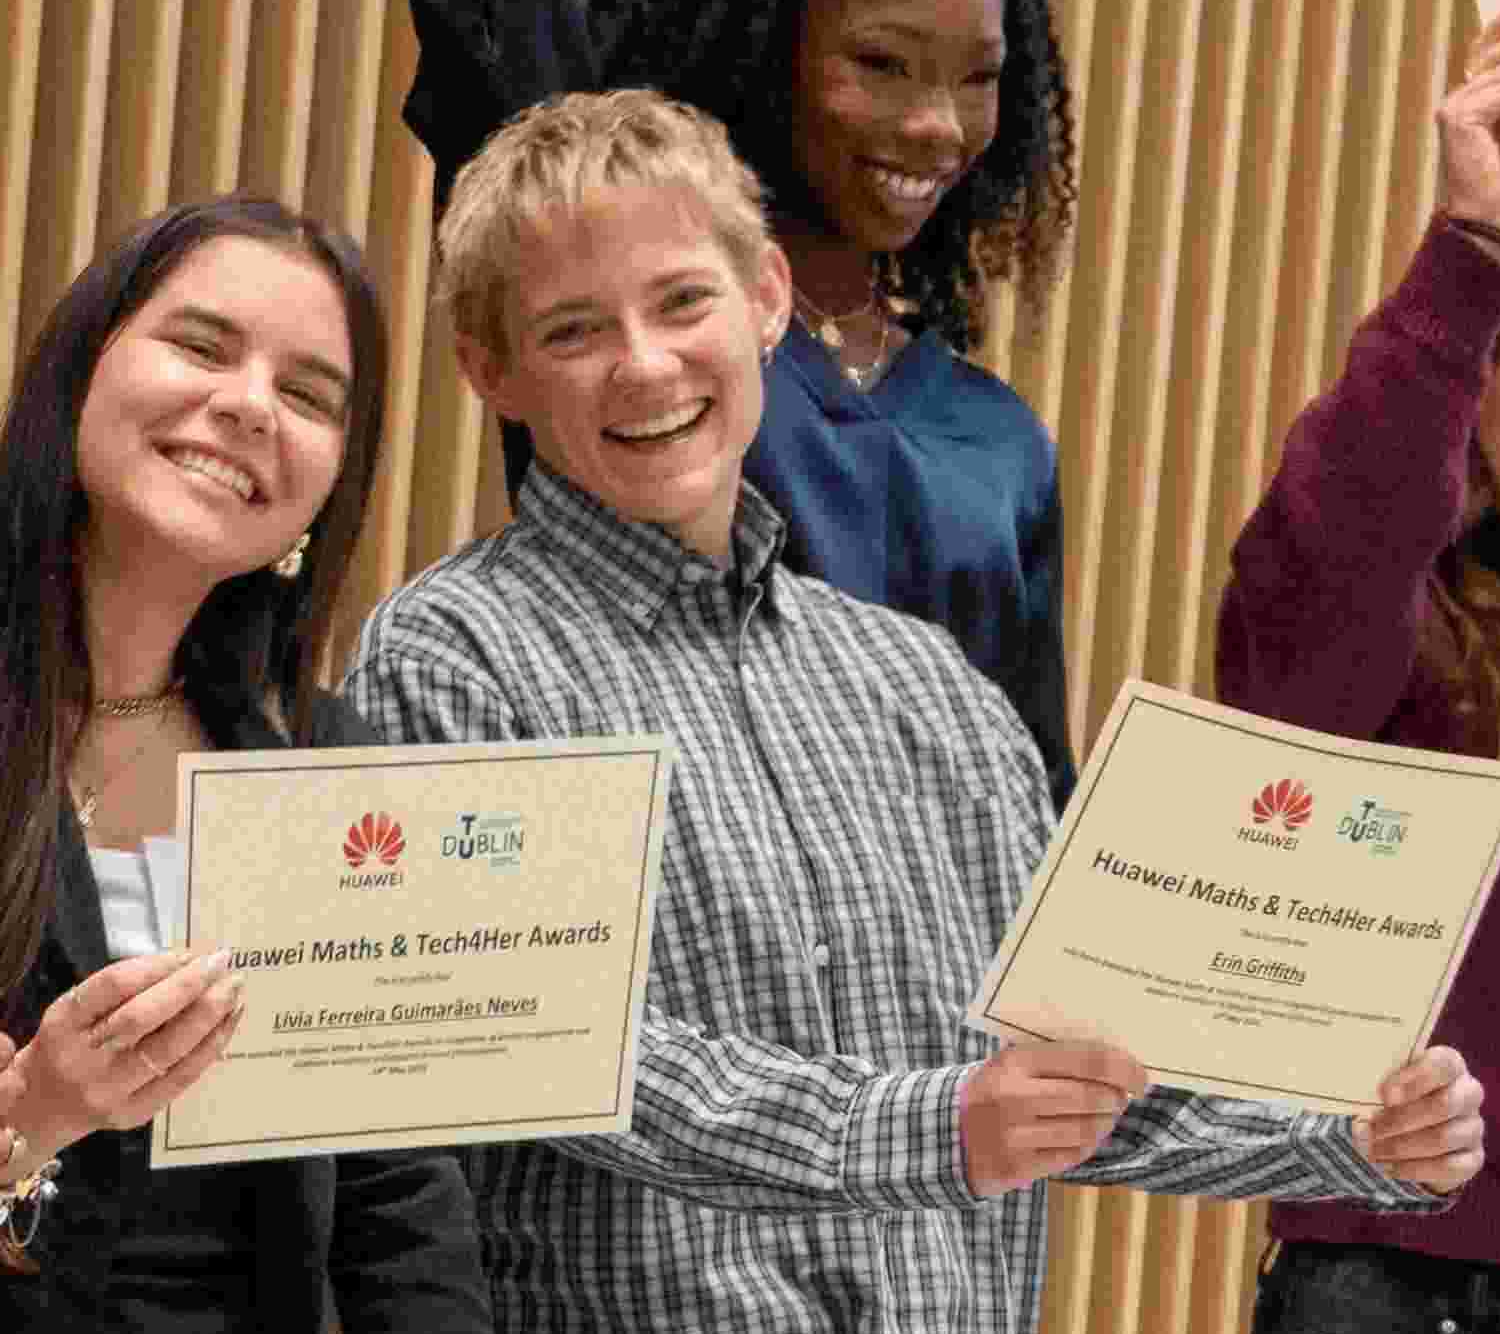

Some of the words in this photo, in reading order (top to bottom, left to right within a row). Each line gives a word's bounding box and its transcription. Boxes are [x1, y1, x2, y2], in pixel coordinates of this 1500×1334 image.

[441, 830, 525, 860] DUBLIN
[1236, 825, 1300, 852] HUAWEI
[338, 870, 405, 891] HUAWEI
[1091, 847, 1187, 895] Huawei
[1189, 878, 1259, 914] Maths
[1262, 894, 1280, 917] &
[1286, 898, 1377, 933] Tech4Her
[1378, 914, 1445, 941] Awards
[311, 933, 384, 964] Maths
[390, 933, 409, 959] &
[415, 924, 523, 957] Tech4Her
[526, 919, 613, 949] Awards
[1210, 950, 1243, 974] Erin
[1245, 957, 1307, 985] Griffiths
[319, 1003, 386, 1028] Ferreira
[391, 995, 482, 1023] Guimarães
[487, 995, 538, 1016] Neves
